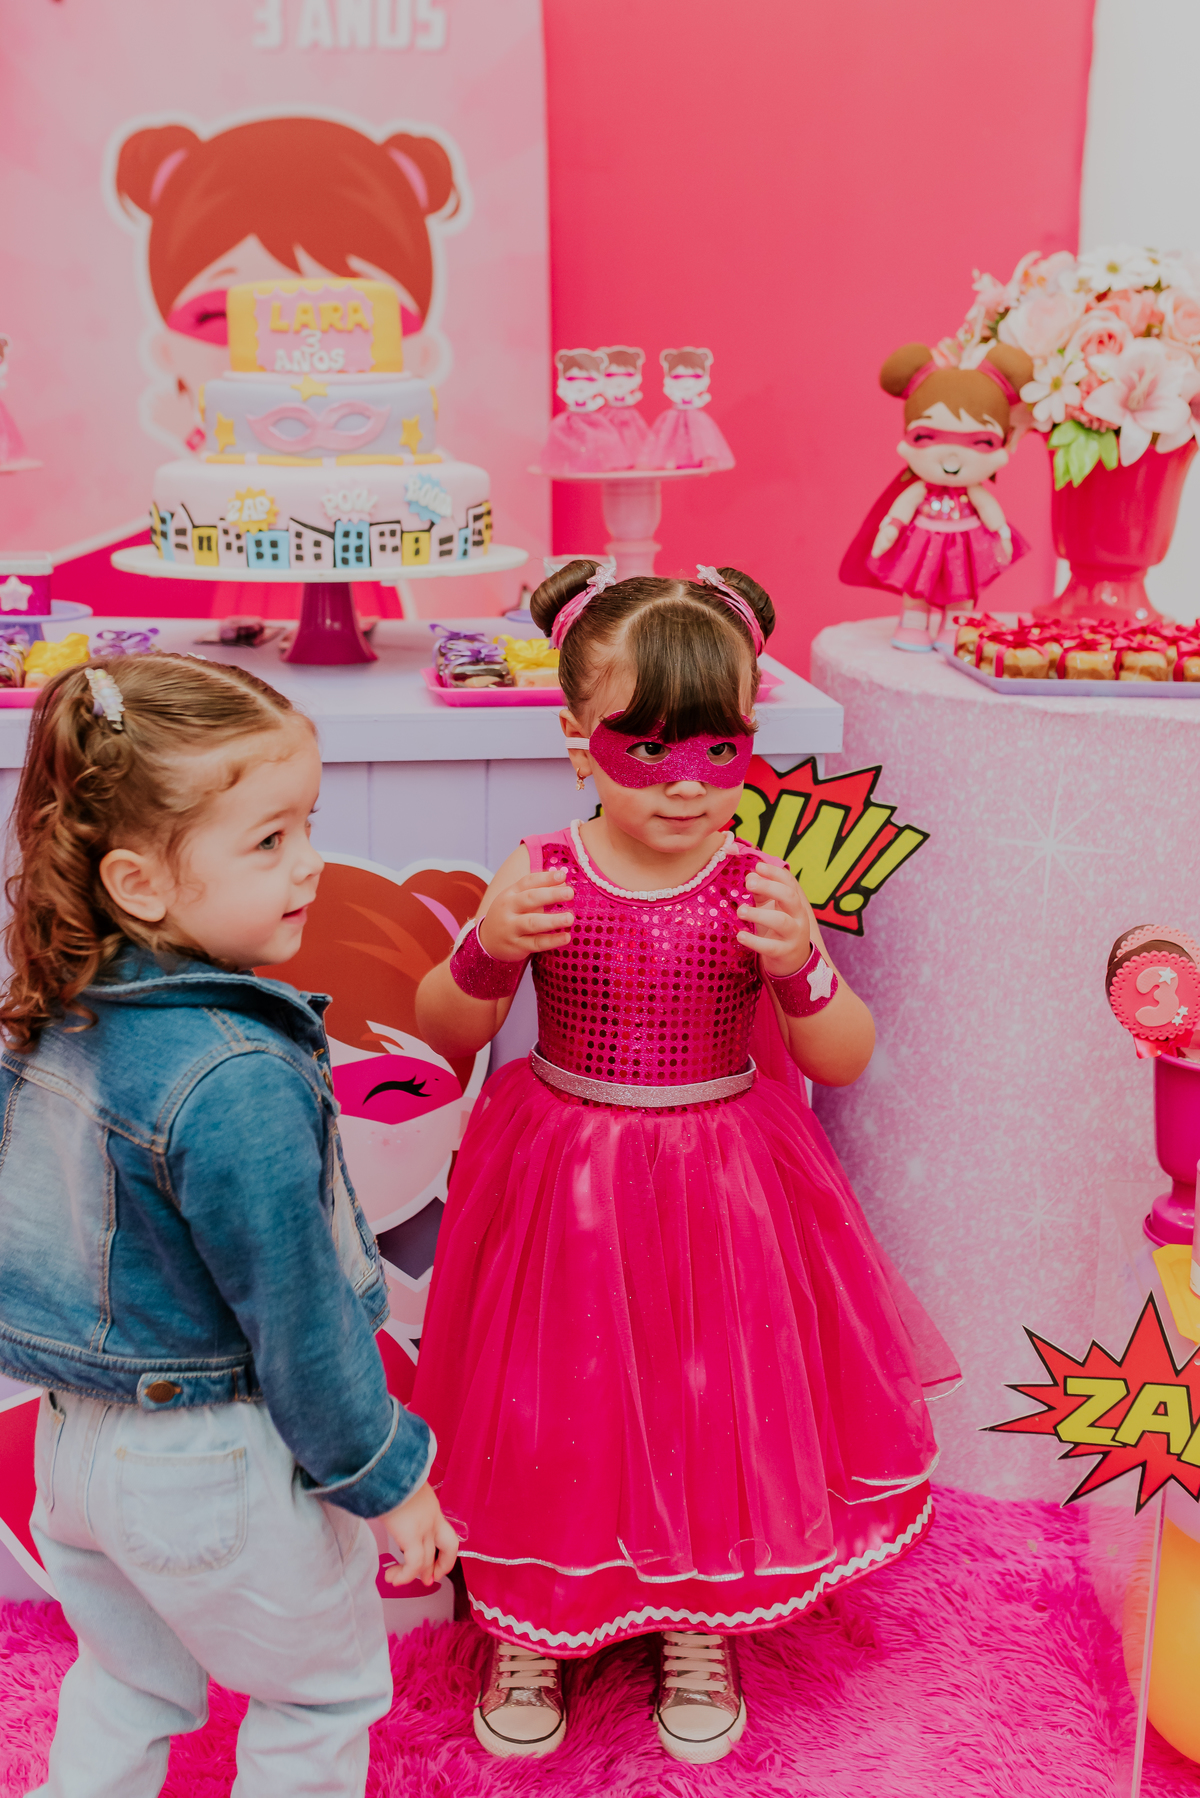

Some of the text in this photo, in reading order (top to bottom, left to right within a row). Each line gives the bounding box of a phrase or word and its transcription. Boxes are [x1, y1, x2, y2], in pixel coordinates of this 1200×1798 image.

[251, 0, 283, 49] 3
[270, 301, 370, 332] LARA
[301, 329, 322, 353] 3
[1135, 966, 1179, 1027] 3
